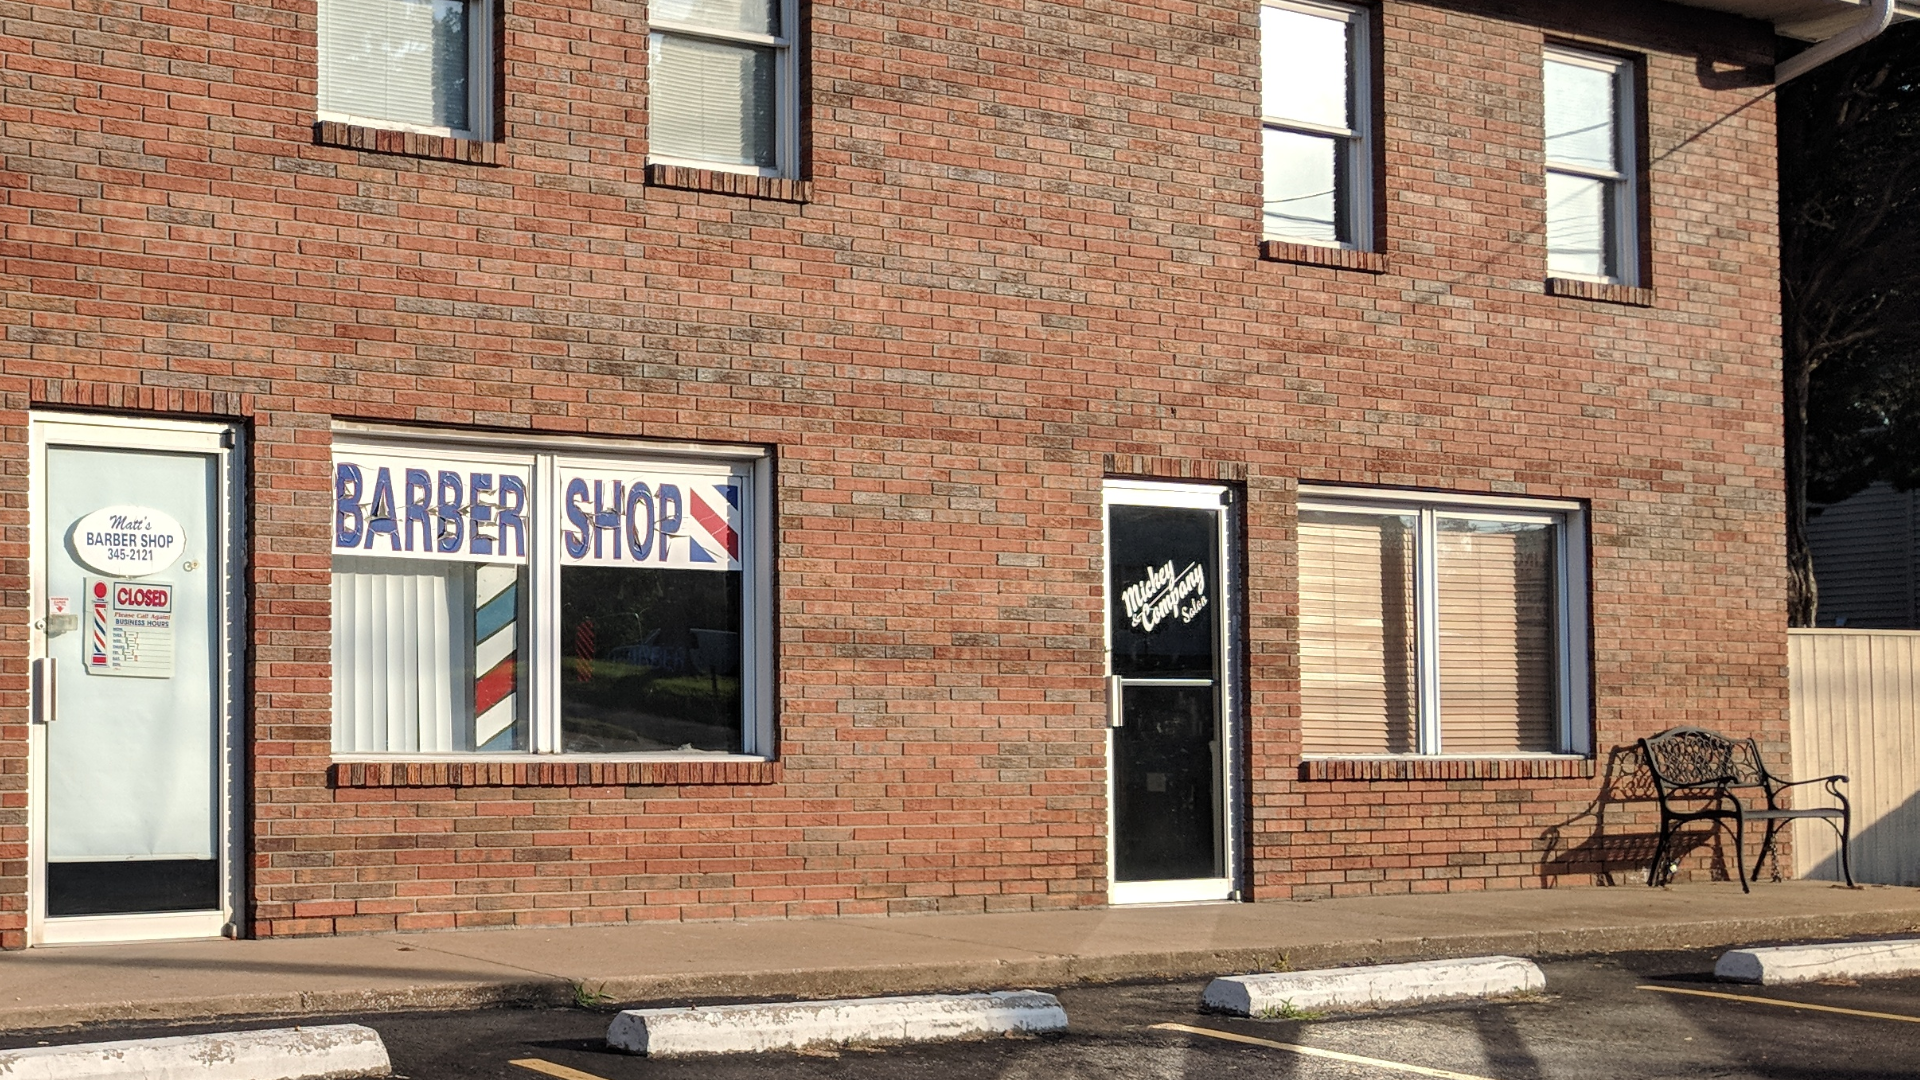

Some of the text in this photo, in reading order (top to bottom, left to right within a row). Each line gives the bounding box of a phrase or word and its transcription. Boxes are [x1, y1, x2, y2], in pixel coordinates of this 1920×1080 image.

[334, 462, 684, 563] BARBER SHOP
[109, 514, 152, 531] Matt's
[86, 532, 174, 548] BARBER SHOP
[107, 548, 153, 561] 345-2121
[117, 587, 168, 607] CLOSED
[1121, 559, 1175, 618] Mickey
[1142, 563, 1204, 632] Company
[1181, 595, 1208, 623] Salon
[115, 618, 145, 626] BUSINESS
